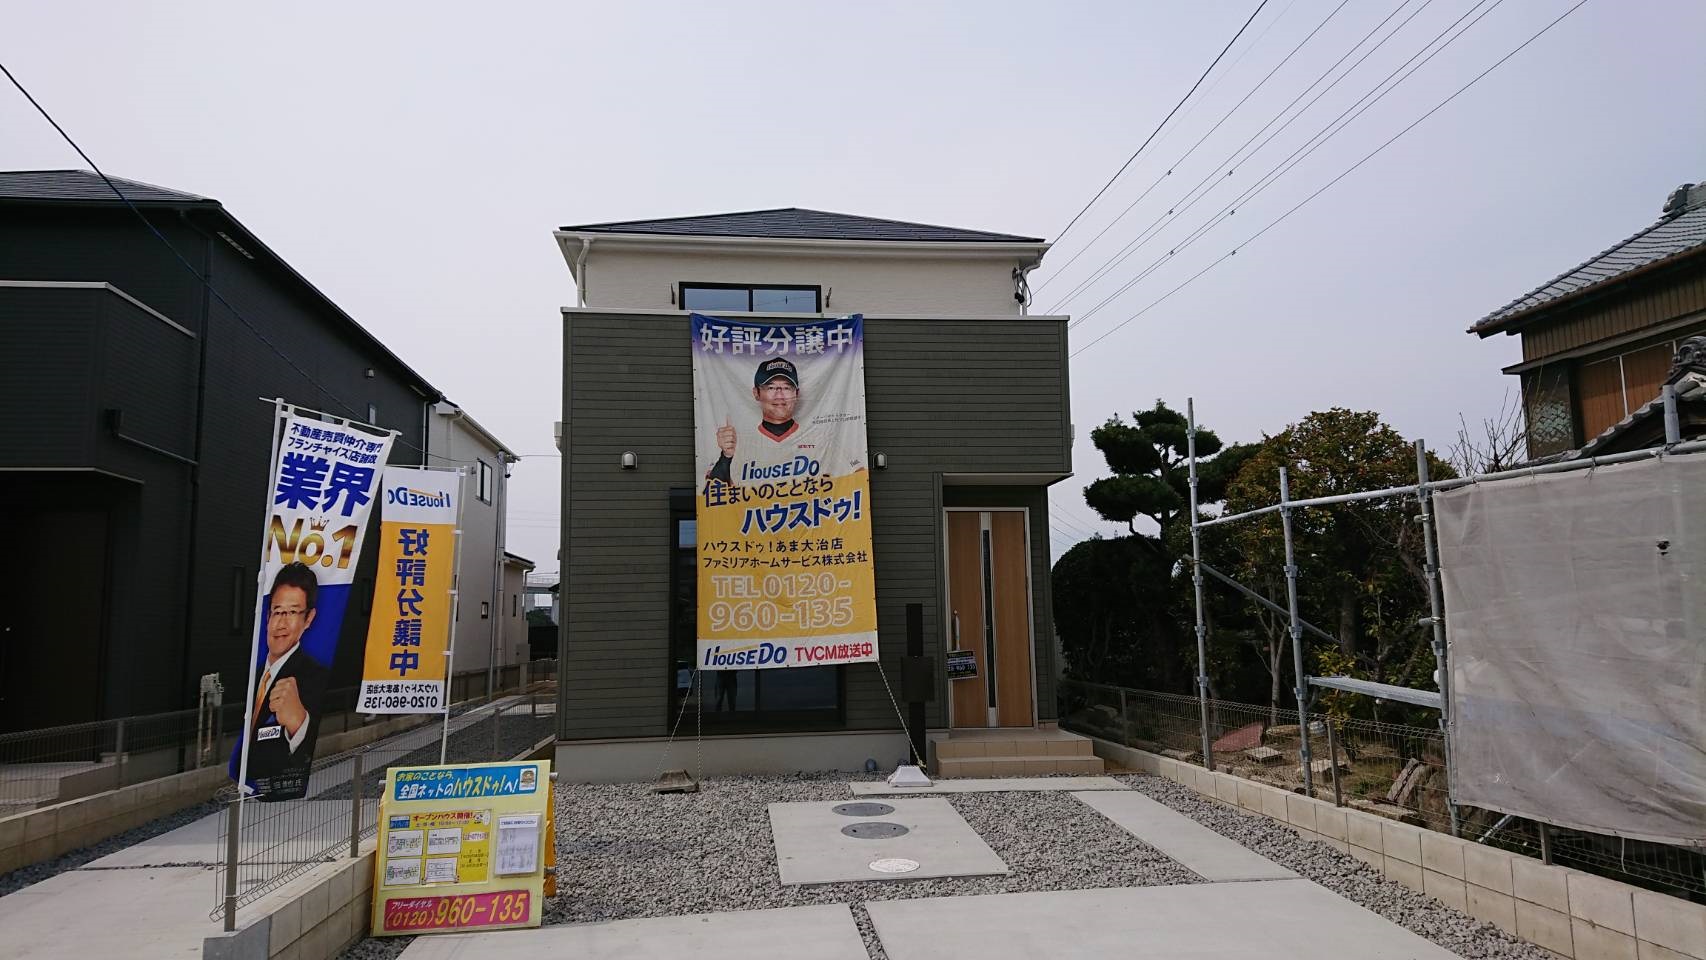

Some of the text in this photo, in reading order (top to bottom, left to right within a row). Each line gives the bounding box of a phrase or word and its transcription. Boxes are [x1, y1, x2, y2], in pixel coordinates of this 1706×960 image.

[700, 323, 853, 355] 好評分譲中
[274, 451, 376, 517] 業界
[702, 474, 833, 507] 住まいのことなら
[266, 514, 361, 570] No.1
[703, 550, 868, 569] ファミリアホームサービス株式会社
[709, 596, 854, 632] 960-135
[794, 641, 873, 663] TVCM放送中
[435, 893, 528, 926] 960-135
